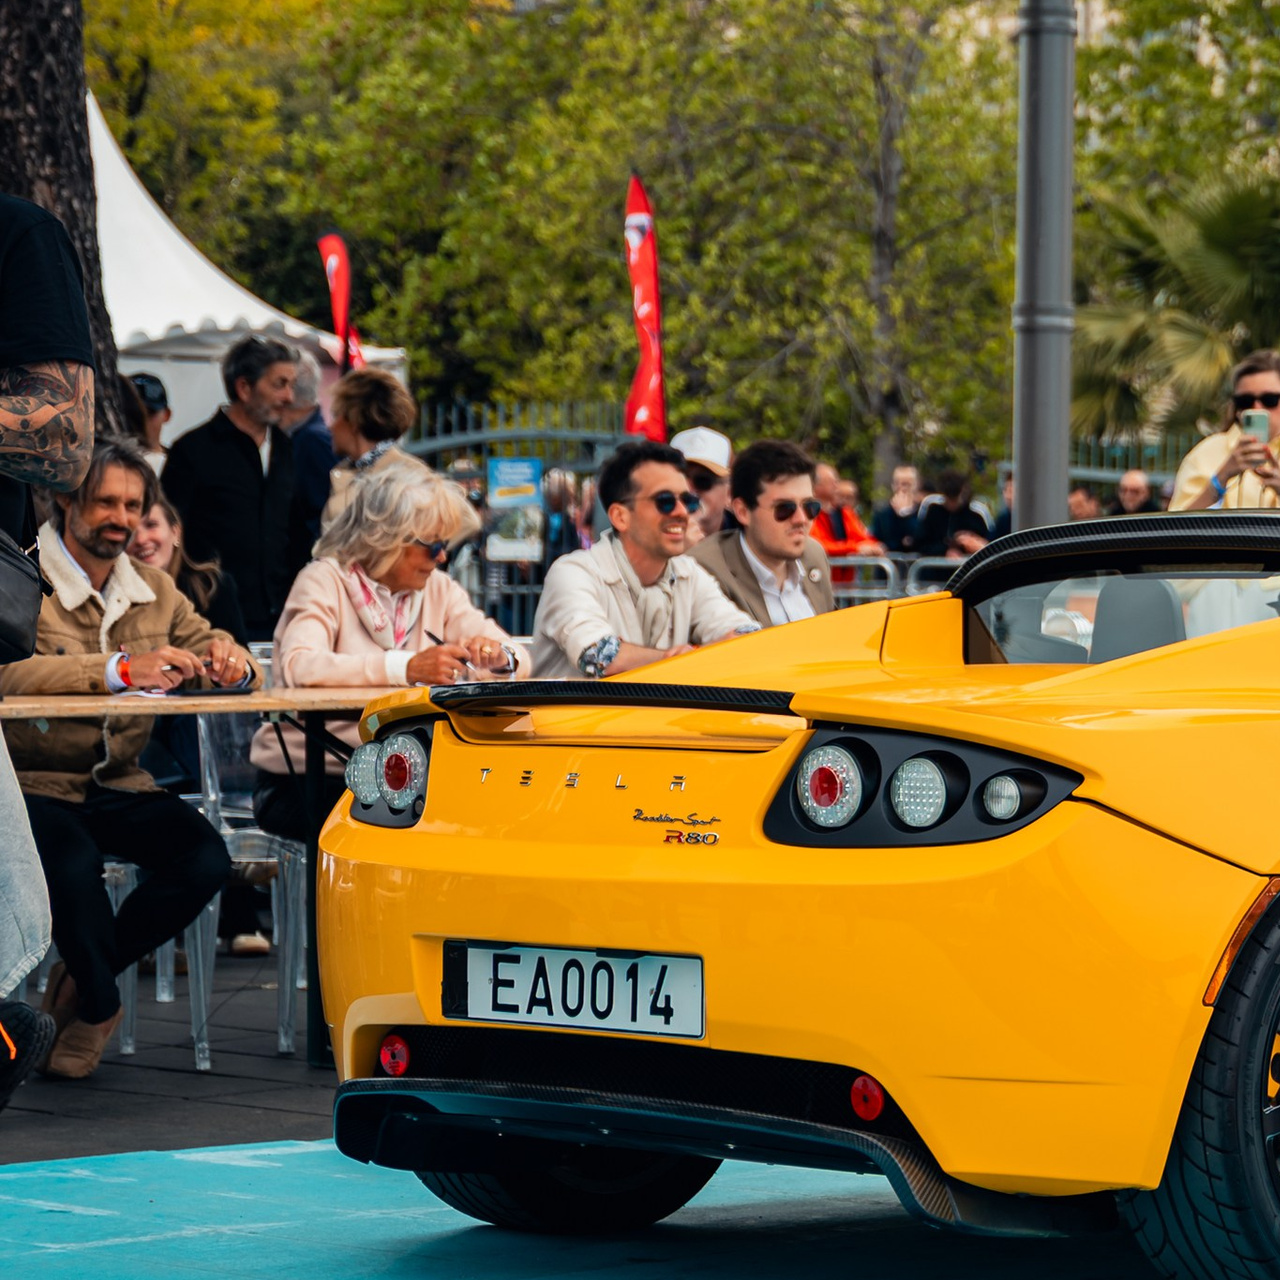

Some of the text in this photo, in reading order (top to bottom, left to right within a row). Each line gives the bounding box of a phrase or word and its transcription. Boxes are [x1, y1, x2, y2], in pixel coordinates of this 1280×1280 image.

[480, 768, 686, 791] TESLA
[683, 812, 721, 827] Sport
[663, 829, 720, 845] R80
[491, 953, 674, 1025] EA0014
